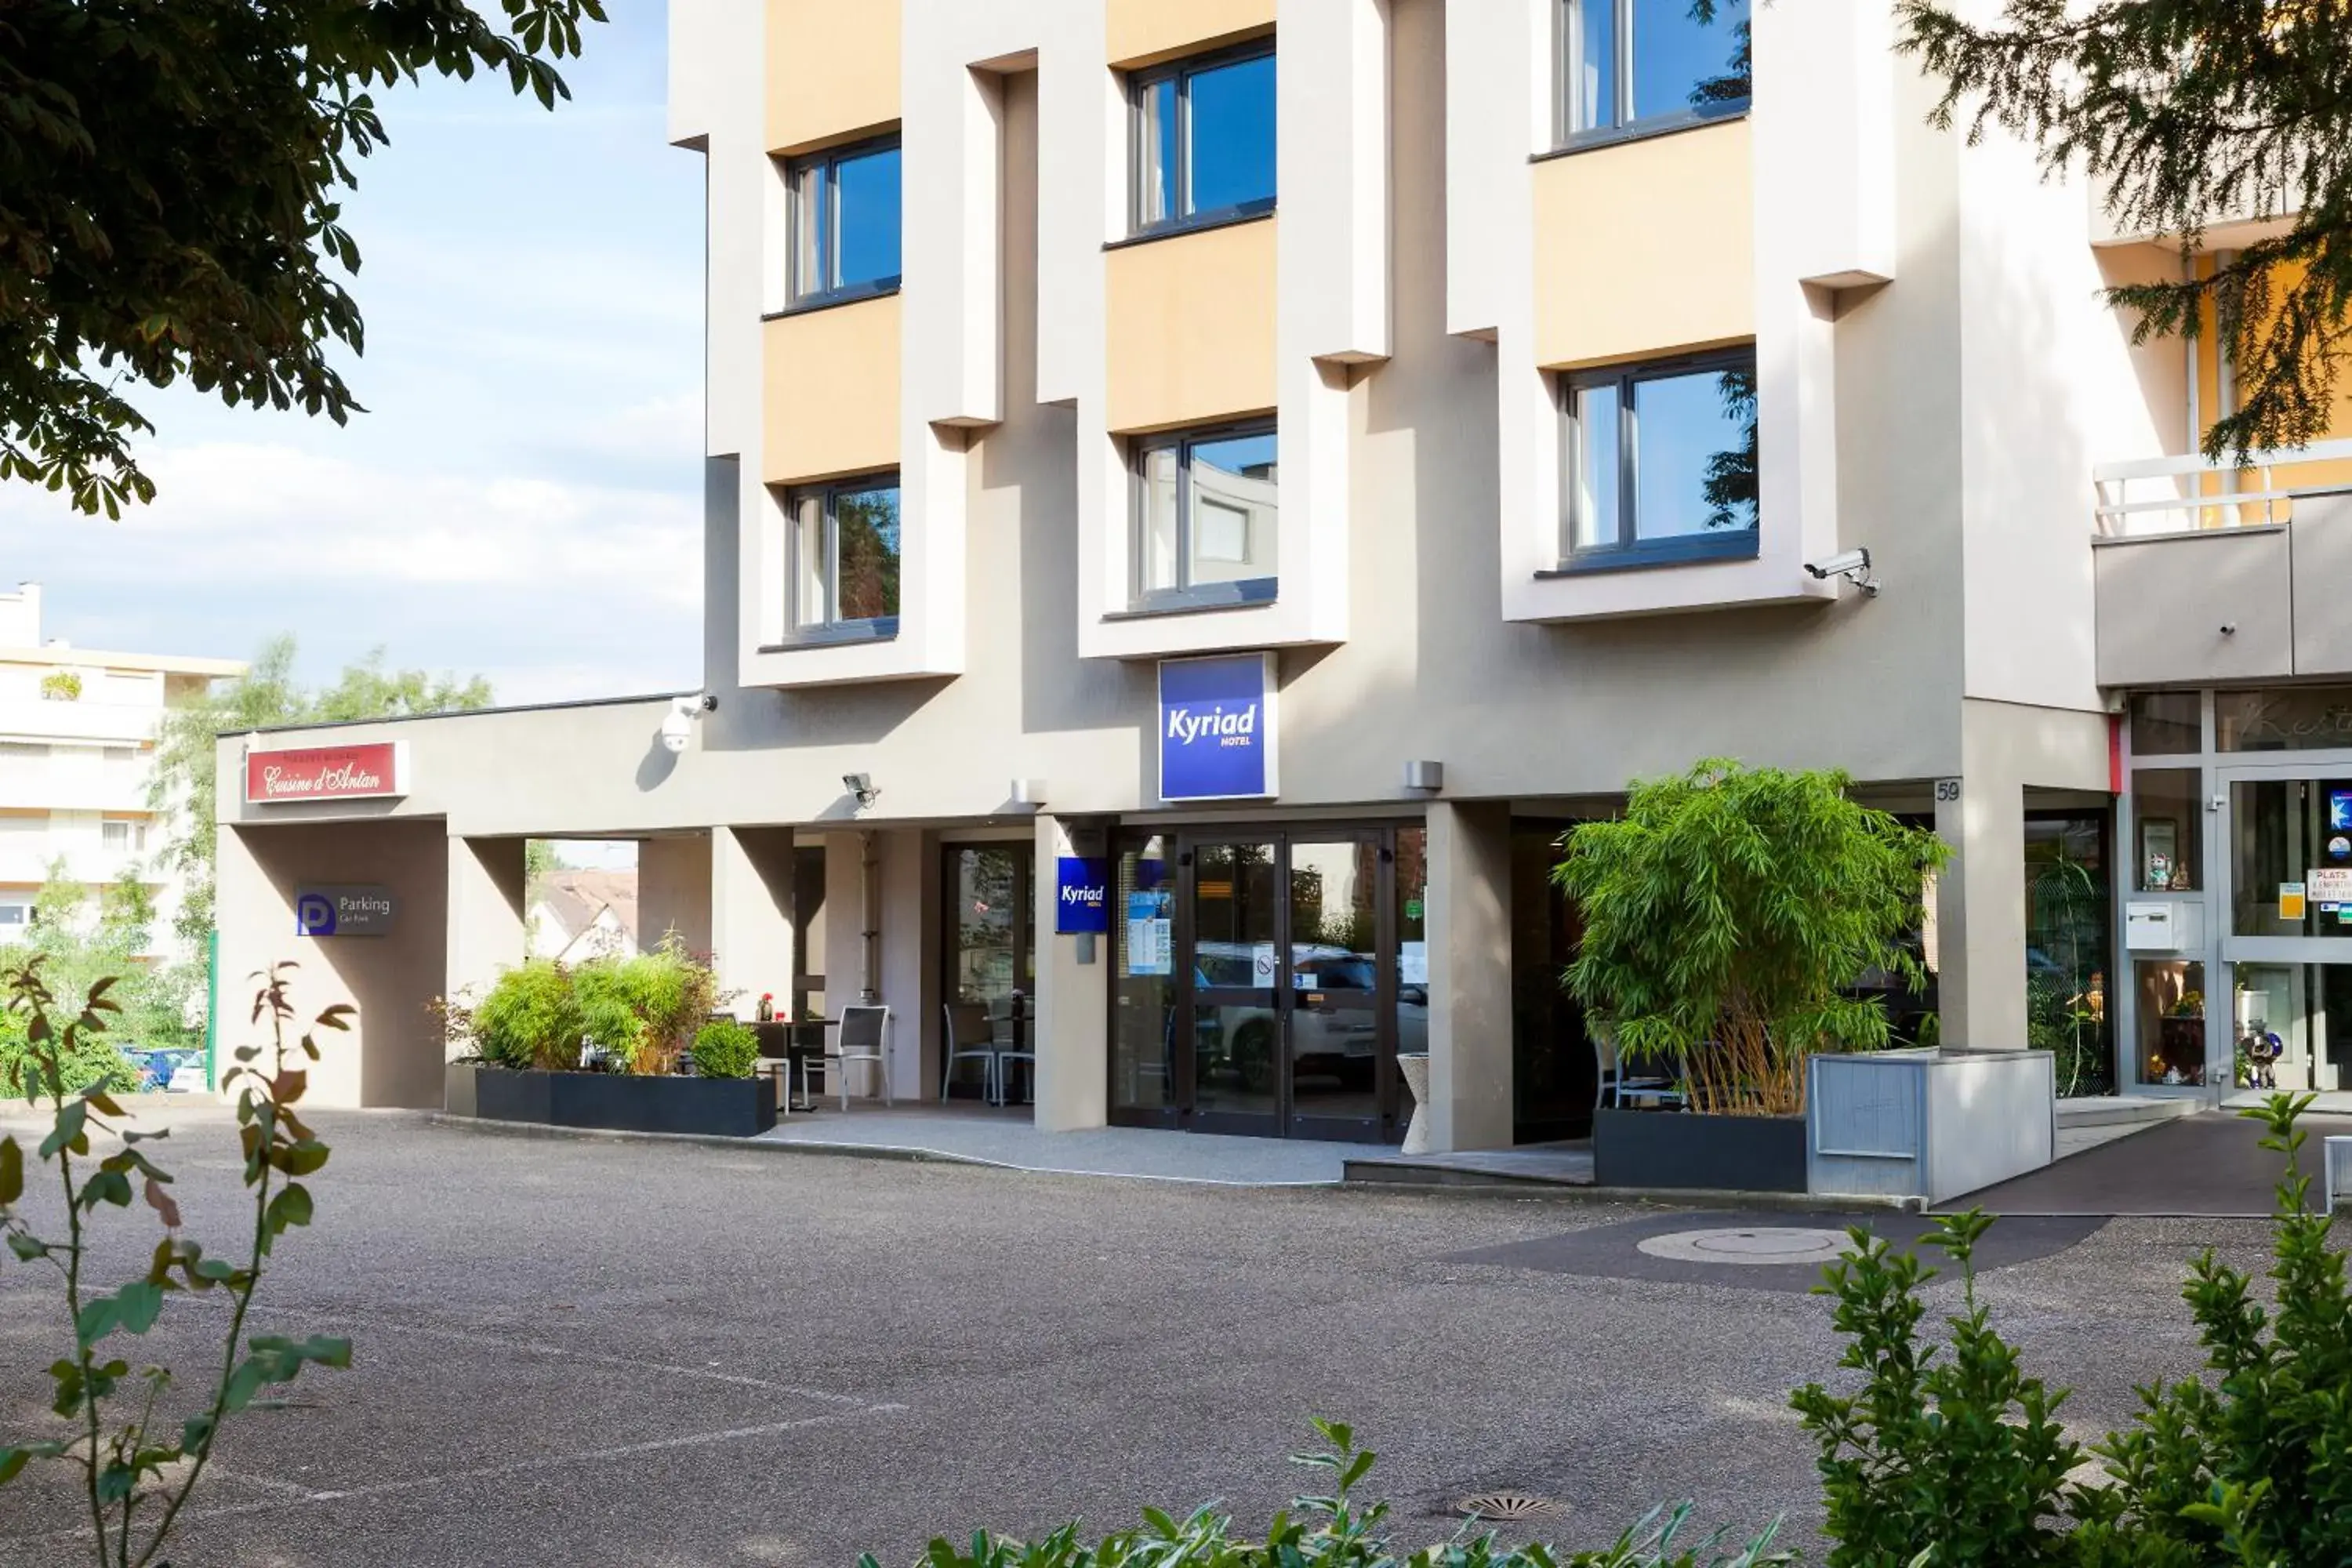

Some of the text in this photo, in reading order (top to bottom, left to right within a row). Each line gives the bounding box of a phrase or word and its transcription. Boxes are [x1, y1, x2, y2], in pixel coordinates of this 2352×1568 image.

[1167, 704, 1256, 746] Kyriad
[1221, 736, 1250, 747] HOTEL
[263, 762, 379, 797] Cuisine d'Antan
[1937, 782, 1959, 800] 59
[1062, 885, 1104, 905] Kyriad
[339, 897, 390, 915] Parking
